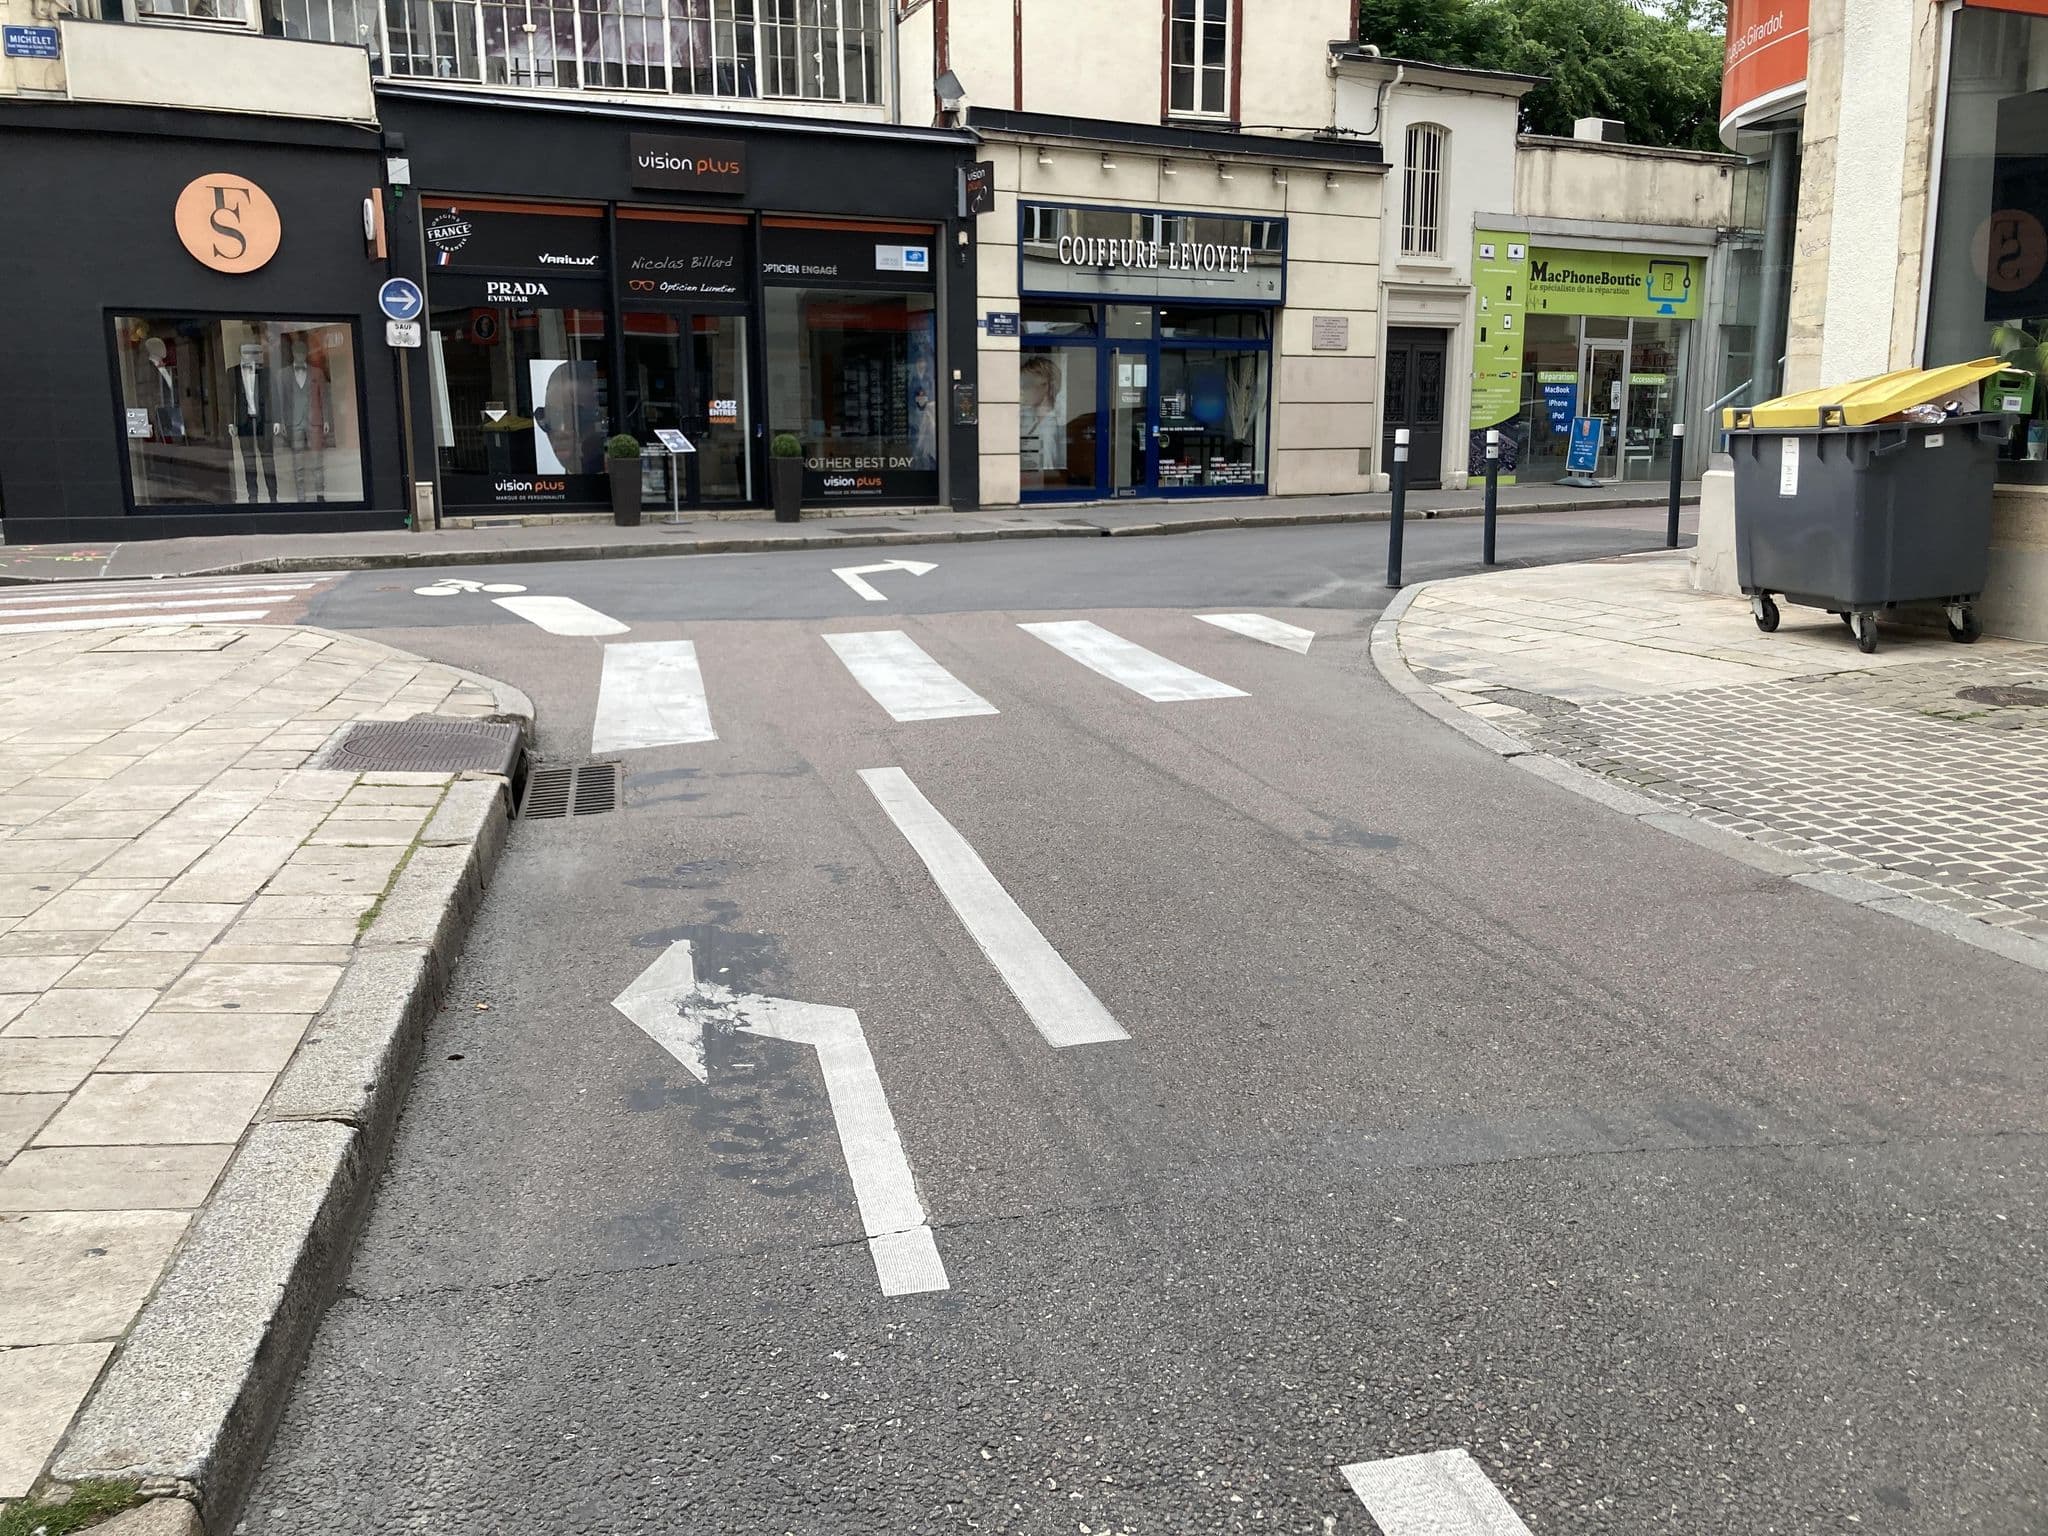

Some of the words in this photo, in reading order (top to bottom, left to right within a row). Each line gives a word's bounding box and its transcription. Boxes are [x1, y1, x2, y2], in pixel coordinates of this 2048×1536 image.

[1747, 10, 1783, 46] Girardot
[9, 35, 51, 45] MICHELET
[638, 151, 692, 170] vision
[696, 158, 740, 175] plus
[427, 224, 470, 239] FRANCE
[1058, 235, 1158, 268] COIFFURE
[1169, 242, 1251, 273] LEVOYET
[631, 257, 684, 270] Nicolas
[691, 256, 733, 268] Billard
[801, 265, 838, 275] ENGAGÉ
[1530, 260, 1641, 287] MacPhoneBoutic
[487, 281, 549, 295] PRADA
[660, 282, 697, 293] Opticien
[700, 283, 736, 293] Lunetier
[1529, 283, 1539, 291] Le
[1540, 284, 1575, 293] spécialiste
[1594, 287, 1630, 295] réparation
[1632, 376, 1665, 384] Accessoires
[1544, 386, 1570, 394] MacBook
[855, 457, 885, 468] BEST
[889, 457, 914, 468] DAY
[495, 479, 532, 491] vision
[535, 481, 565, 493] plus
[823, 476, 855, 487] vision
[856, 477, 882, 488] plus
